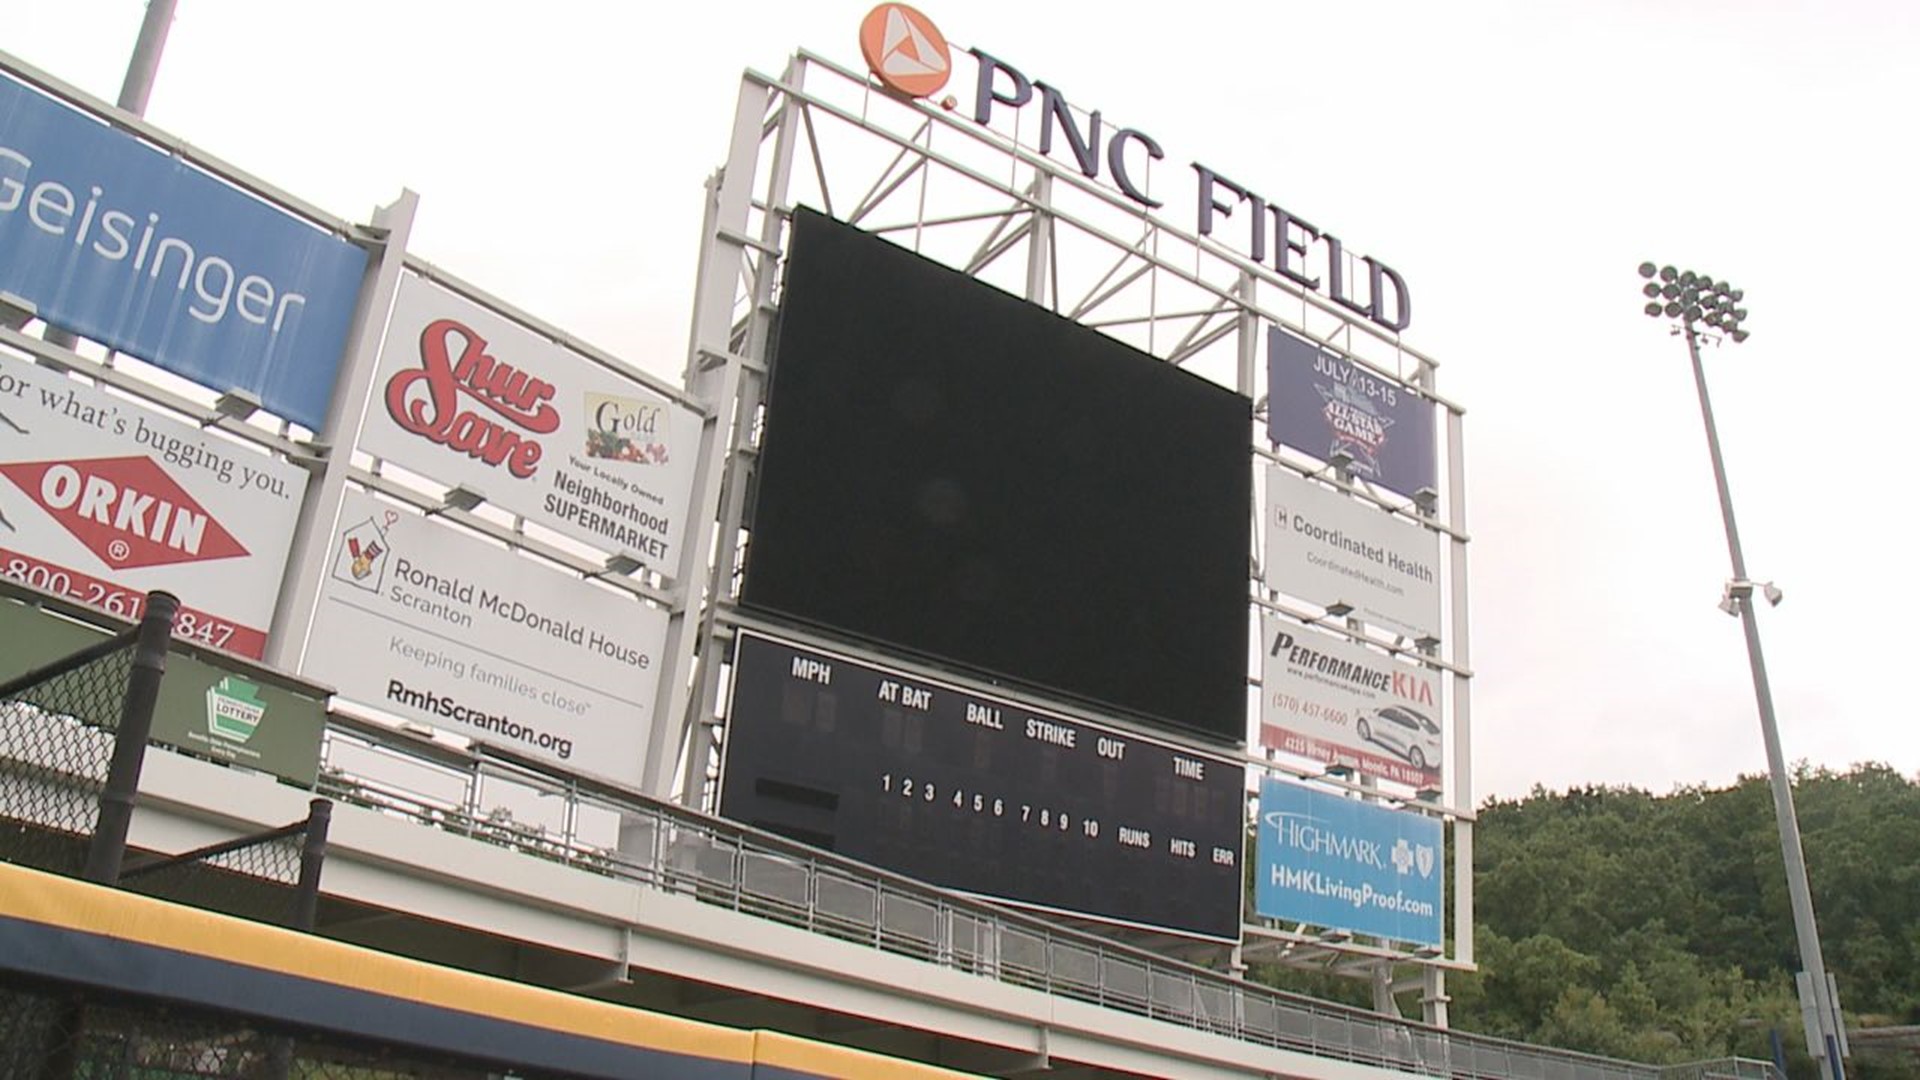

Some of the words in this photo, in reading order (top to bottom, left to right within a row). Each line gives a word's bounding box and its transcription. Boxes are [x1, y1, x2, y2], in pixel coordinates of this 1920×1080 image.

[968, 46, 1164, 209] PNC
[1190, 161, 1412, 333] FIELD
[0, 147, 306, 332] Geisinger
[412, 318, 557, 414] Shur
[1313, 354, 1350, 384] JULY
[1360, 376, 1397, 407] 13-15
[0, 366, 31, 398] or
[40, 387, 126, 435] what's
[134, 417, 235, 483] bugging
[238, 467, 290, 499] you.
[385, 370, 543, 480] Save
[595, 400, 661, 435] Gold
[40, 464, 208, 556] ORKIN
[553, 469, 669, 535] Neighborhood
[569, 455, 592, 472] Your
[594, 467, 629, 491] Locally
[631, 483, 664, 506] Owned
[543, 493, 669, 561] SUPERMARKET
[1293, 515, 1384, 564] Coordinated
[1388, 550, 1433, 585] Health
[390, 585, 473, 629] Scranton
[394, 558, 475, 605] Ronald
[478, 589, 585, 646] McDonald
[588, 630, 650, 670] House
[390, 635, 466, 679] Keeping
[470, 663, 537, 700] families
[791, 656, 831, 685] MPH
[878, 679, 899, 702] AT
[902, 686, 932, 711] BAT
[1270, 631, 1392, 693] PERFORMANCE
[1392, 669, 1434, 707] KIA
[216, 702, 259, 723] LOTTERY
[386, 679, 573, 758] RmhScranton.org
[966, 703, 1004, 730] BALL
[1026, 718, 1076, 748] STRIKE
[1272, 691, 1300, 716] (570)
[1097, 737, 1126, 760] OUT
[1173, 756, 1205, 780] TIME
[882, 774, 891, 792] 1
[902, 778, 913, 796] 2
[924, 783, 935, 801] 3
[953, 789, 963, 808] 4
[973, 794, 984, 812] 5
[993, 798, 1004, 816] 6
[1021, 805, 1031, 823] 7
[1040, 809, 1050, 826] 8
[1059, 813, 1069, 831] 9
[1083, 820, 1099, 838] 10
[1118, 826, 1151, 849] RUNS
[1170, 838, 1196, 858] HITS
[1212, 847, 1235, 866] ERR
[1271, 863, 1433, 917] HMKLivingProof.com
